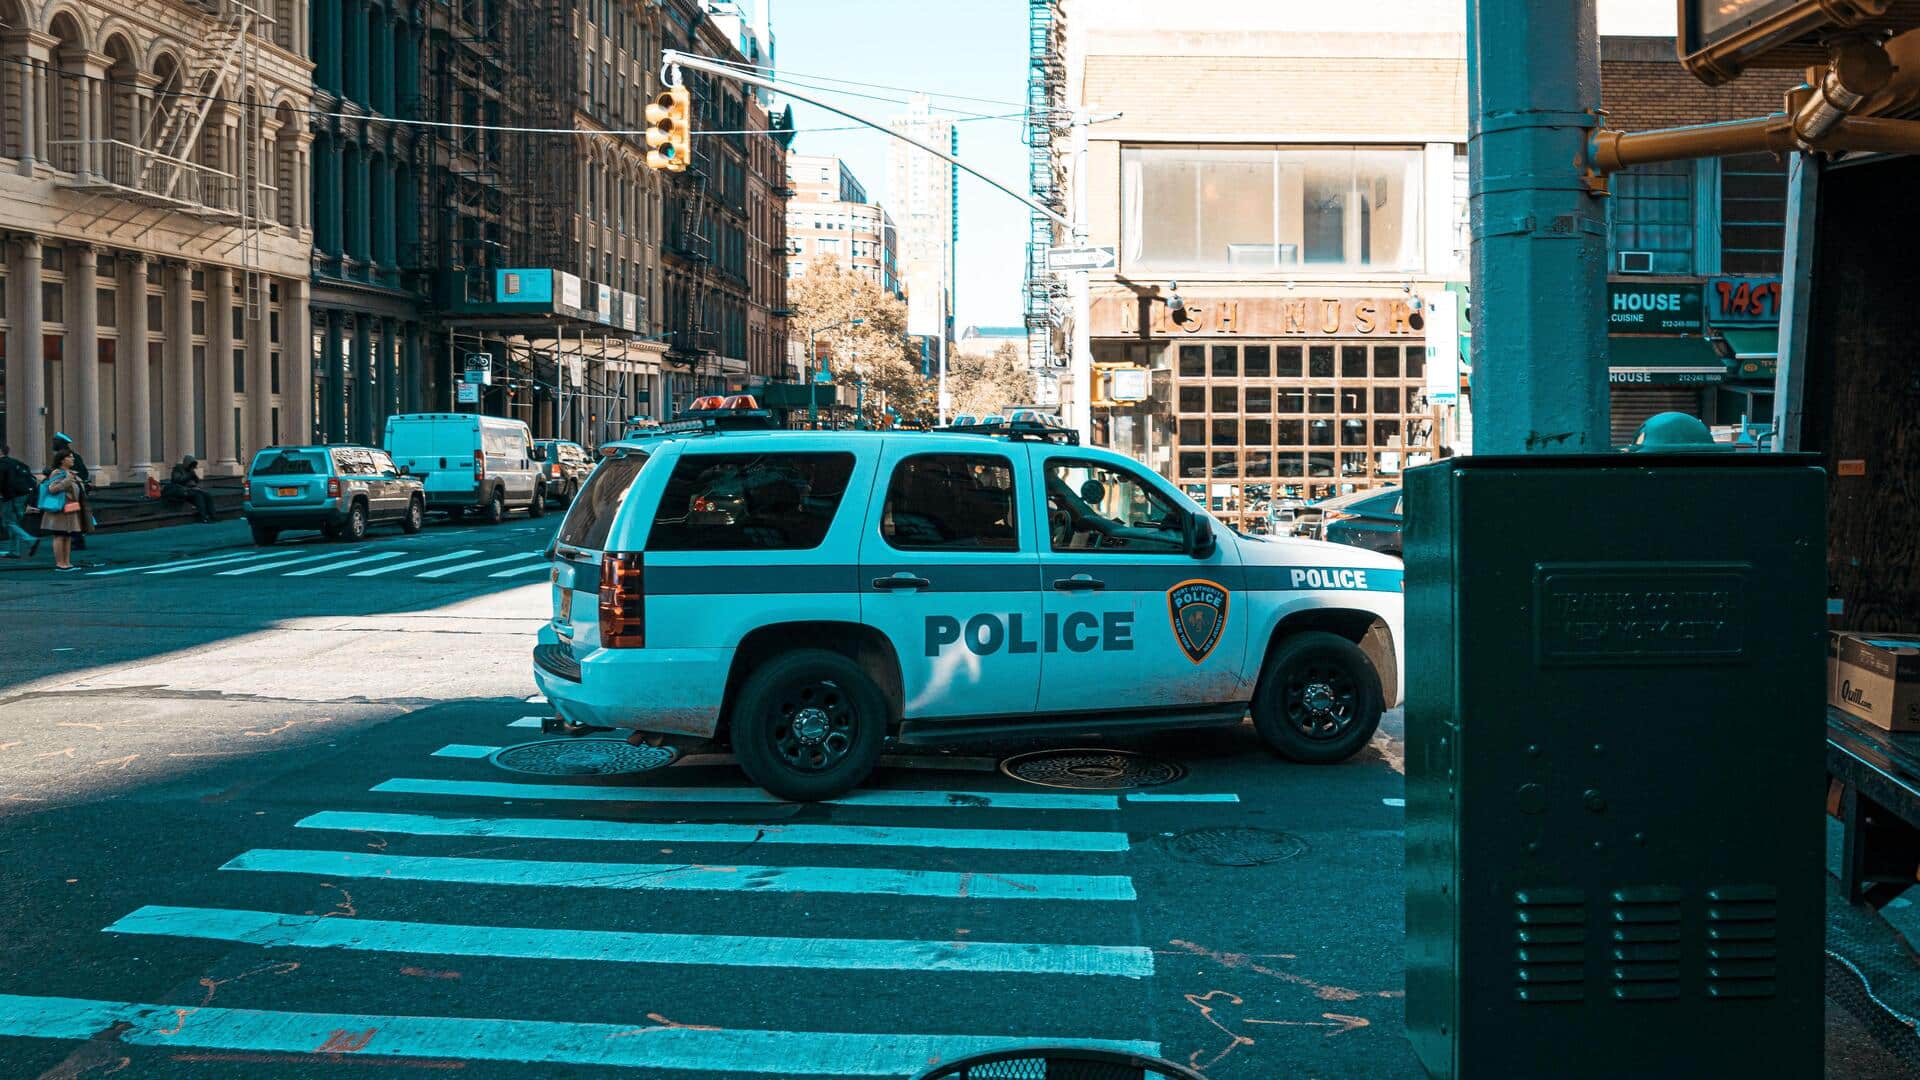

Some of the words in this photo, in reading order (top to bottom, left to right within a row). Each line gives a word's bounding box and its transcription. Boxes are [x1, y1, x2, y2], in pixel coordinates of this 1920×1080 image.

[1613, 293, 1681, 311] HOUSE
[1120, 301, 1239, 334] NISH
[1611, 313, 1644, 322] CUISINE
[1609, 373, 1652, 383] HOUSE
[1290, 568, 1369, 590] POLICE
[1175, 592, 1222, 608] POLICE
[924, 611, 1135, 657] POLICE
